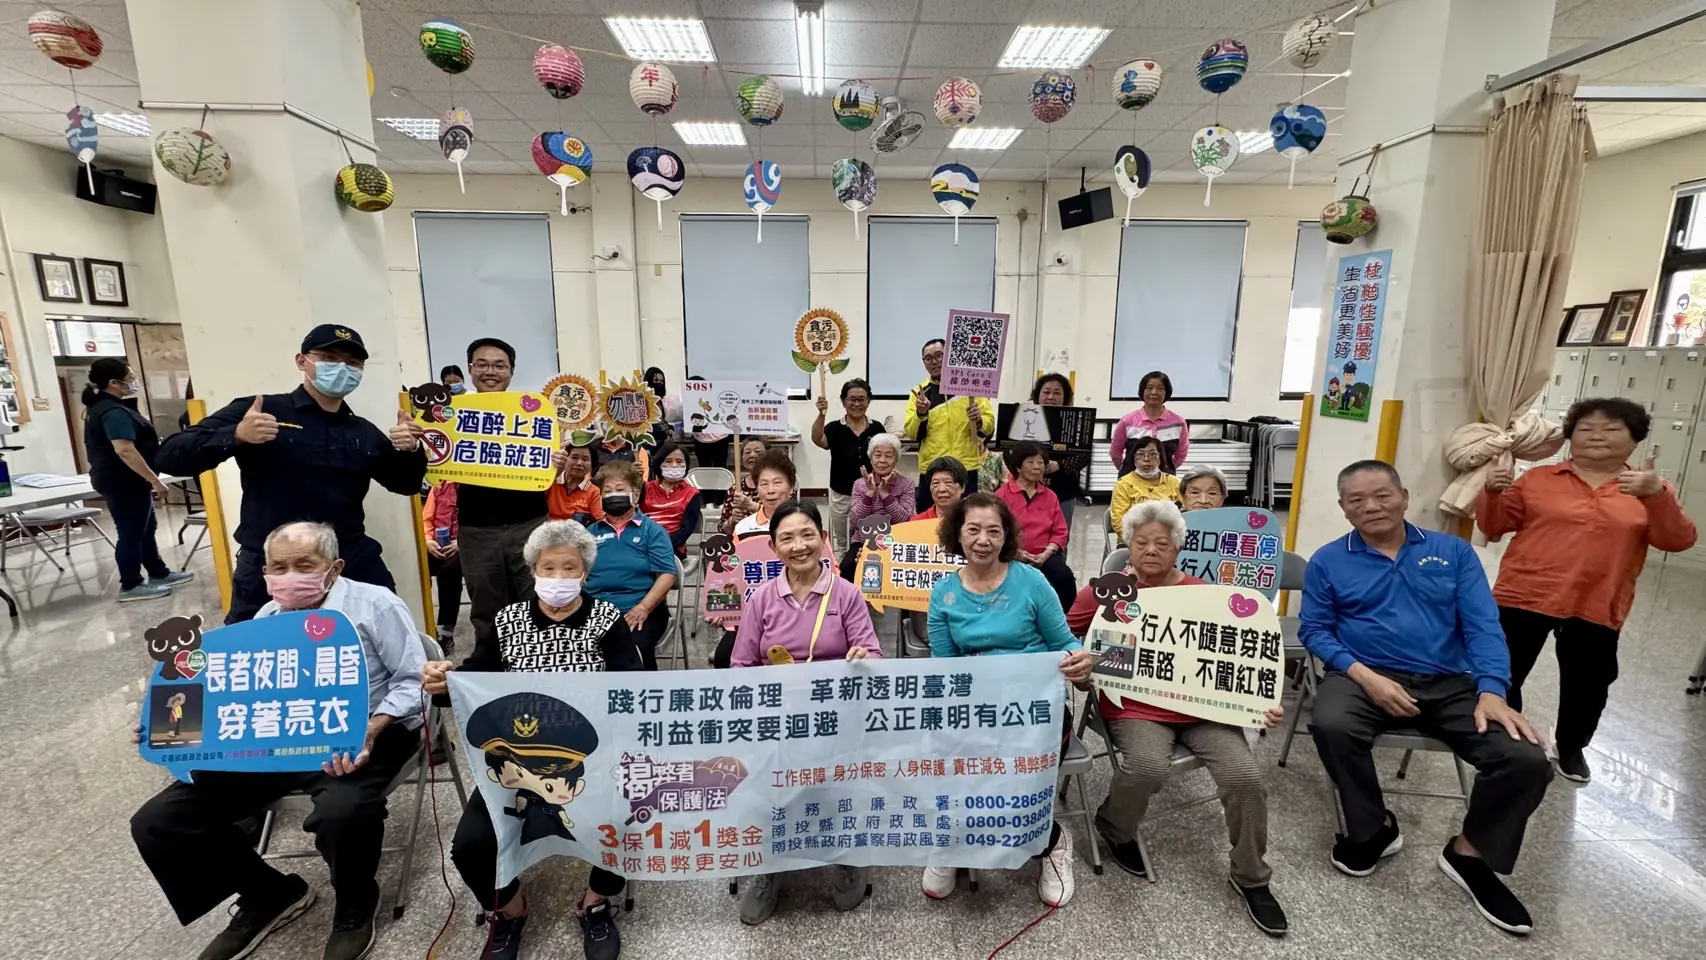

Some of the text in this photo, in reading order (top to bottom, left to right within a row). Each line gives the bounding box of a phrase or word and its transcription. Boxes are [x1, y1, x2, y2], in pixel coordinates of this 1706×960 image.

[1334, 266, 1361, 359] 生活更美好
[1352, 261, 1383, 360] 杜絕性騷擾
[685, 382, 713, 391] SOS!
[456, 409, 553, 440] 酒醉上道
[429, 433, 445, 449] 酒
[453, 439, 551, 469] 危險就到
[1183, 530, 1279, 559] 路口慢看停
[1180, 558, 1276, 588] 行人優先行
[1140, 612, 1281, 663] 行人不隨意穿越
[205, 644, 360, 693] 長者夜間、晨昏
[1136, 647, 1277, 700] 馬路，不闖紅燈
[607, 672, 974, 715] 踐行廉政倫理 革新透明臺灣
[217, 696, 350, 741] 穿著亮衣
[637, 699, 1051, 747] 利益衝突要迴避 公正廉明有公信
[772, 751, 1058, 788] 工作保障 身分保密 人身保護 責任減免 揭弊獎金
[660, 788, 727, 811] 保護法
[965, 785, 1054, 809] 0800-286586
[966, 802, 1052, 828] 0800-038800
[597, 819, 763, 853] 3保1減1獎金
[601, 850, 763, 874] 讓你揭弊更安心
